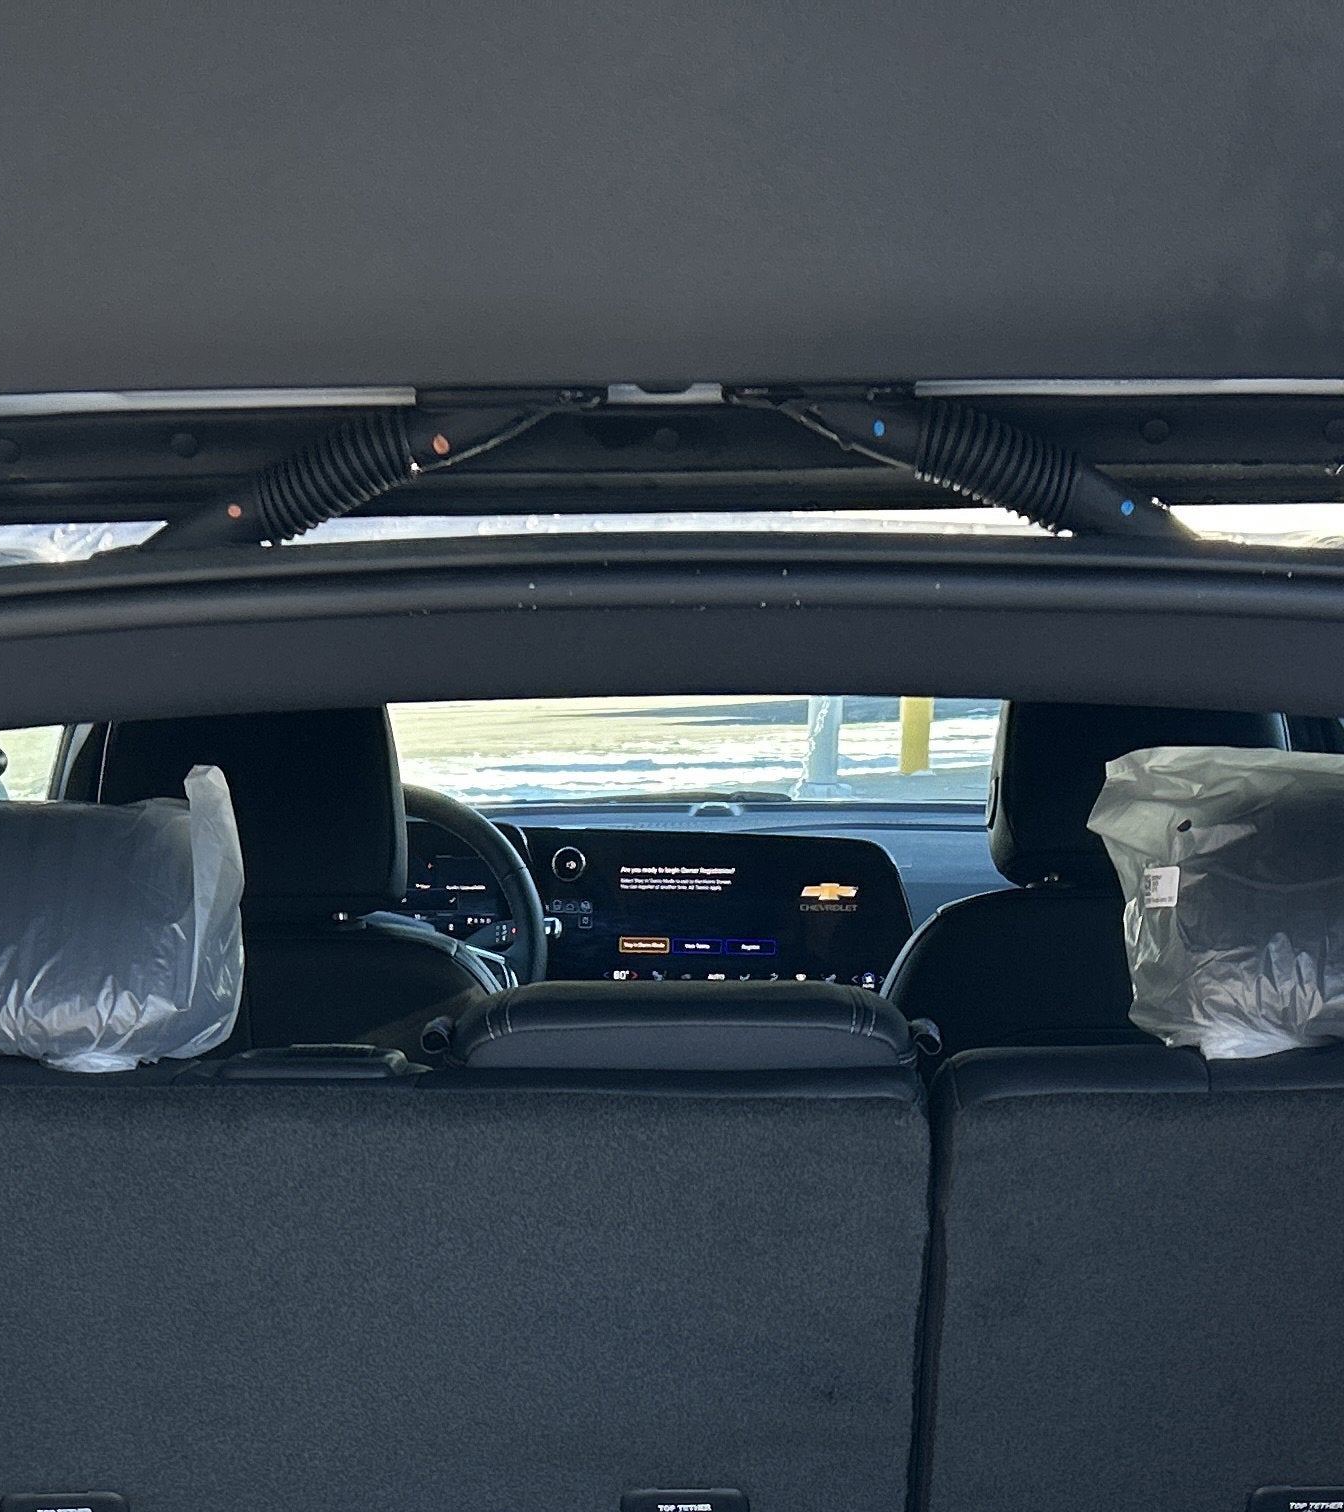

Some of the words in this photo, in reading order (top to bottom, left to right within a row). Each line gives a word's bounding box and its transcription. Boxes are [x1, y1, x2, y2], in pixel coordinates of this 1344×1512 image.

[799, 904, 858, 912] CHEVROLET
[657, 1504, 676, 1512] TOP
[677, 1503, 712, 1512] TETHER
[1289, 1502, 1308, 1510] TOP
[1309, 1501, 1344, 1510] TETHER
